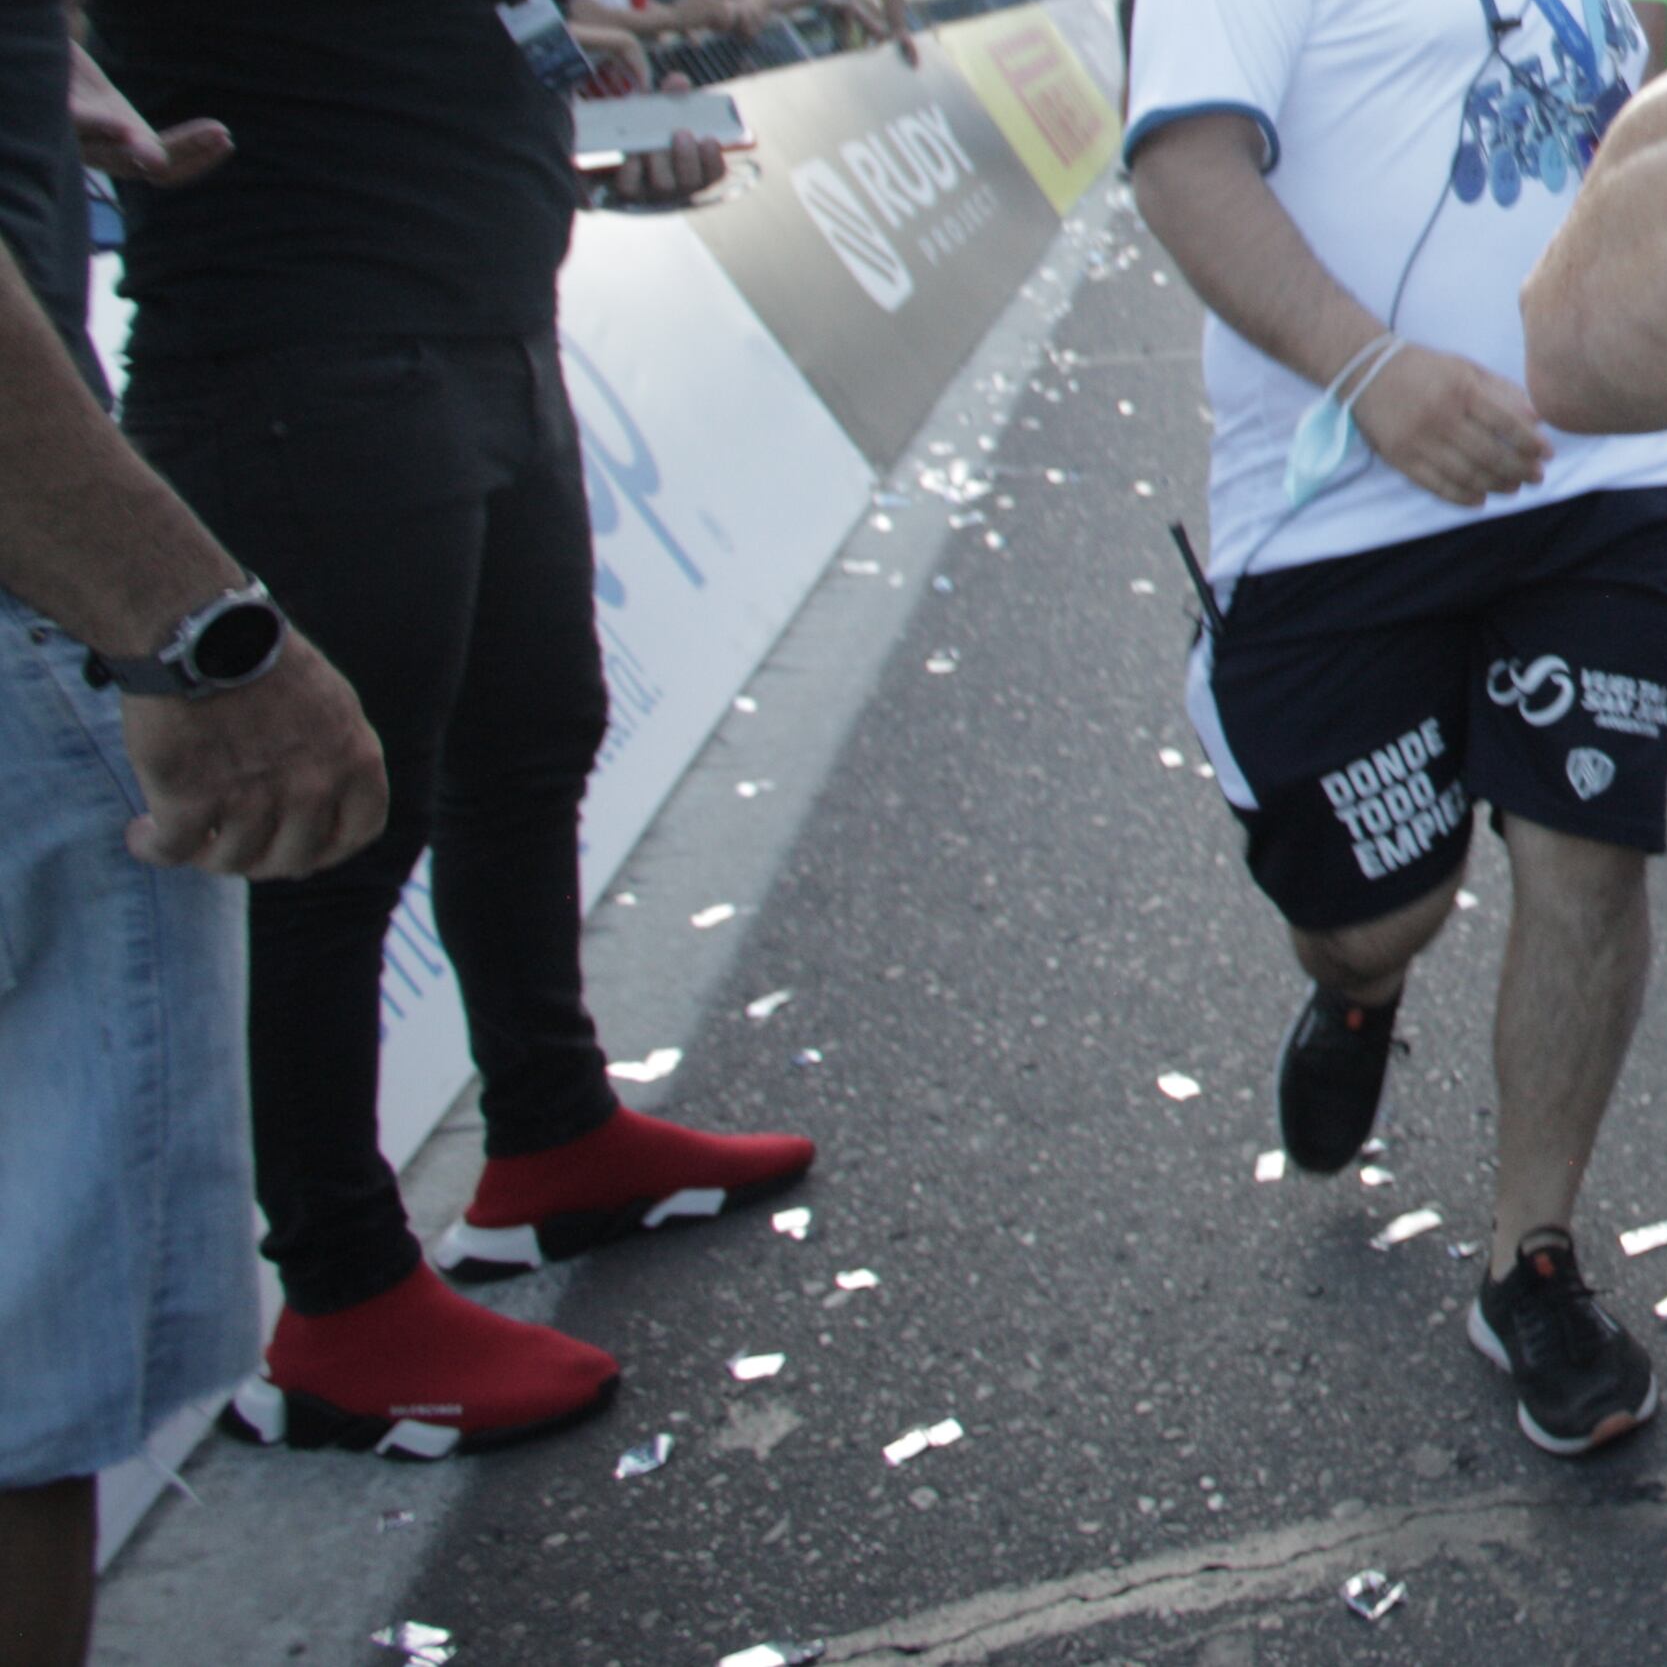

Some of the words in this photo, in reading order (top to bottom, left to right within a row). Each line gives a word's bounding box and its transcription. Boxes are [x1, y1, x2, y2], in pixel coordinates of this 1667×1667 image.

[840, 100, 976, 230] RUDY
[1319, 715, 1447, 811] DONDE
[1334, 770, 1436, 844] TODO
